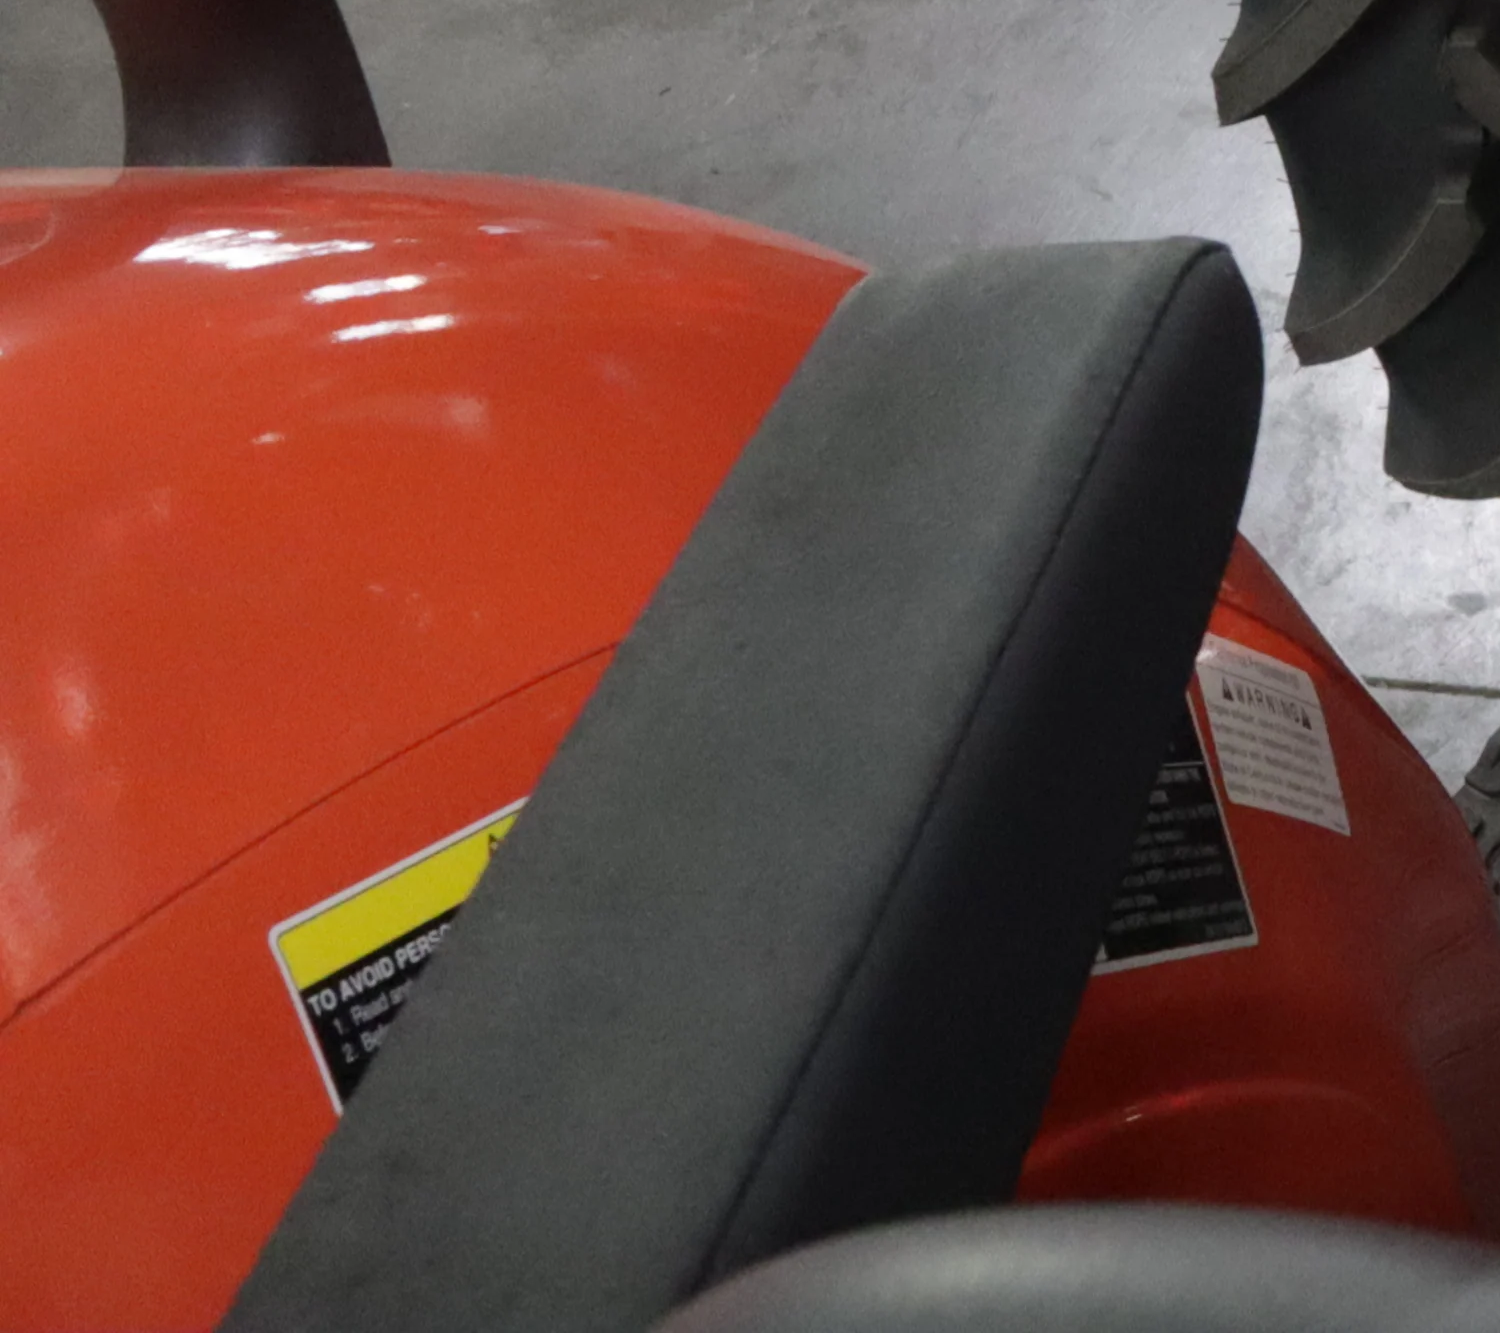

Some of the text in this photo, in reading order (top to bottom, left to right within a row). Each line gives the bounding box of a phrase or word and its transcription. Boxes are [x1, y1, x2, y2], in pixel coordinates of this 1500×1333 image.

[1233, 682, 1301, 724] WARNING
[306, 988, 338, 1017] TO
[339, 956, 396, 1001] AVOID
[350, 995, 389, 1025] Read
